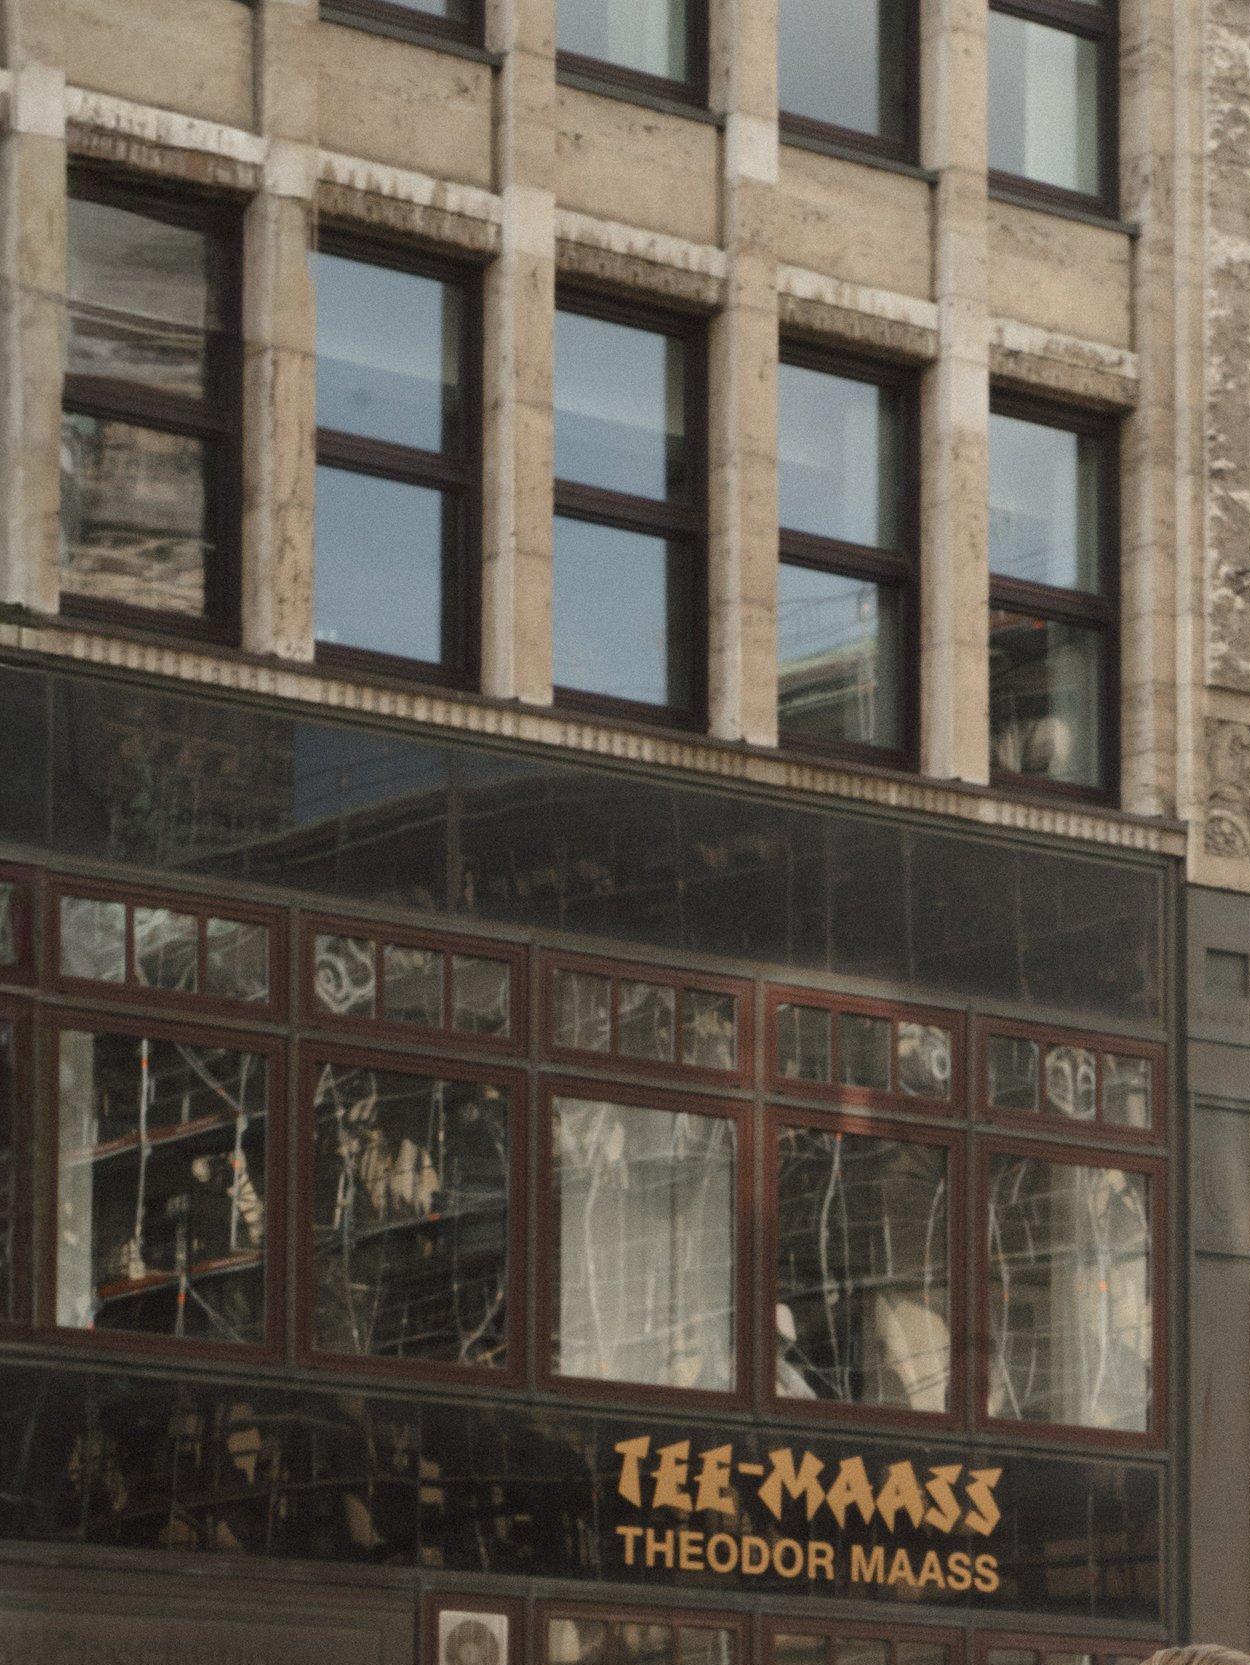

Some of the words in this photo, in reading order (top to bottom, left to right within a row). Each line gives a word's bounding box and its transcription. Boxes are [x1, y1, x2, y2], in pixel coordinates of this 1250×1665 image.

[614, 1435, 1003, 1537] TEE-MAASS
[616, 1526, 835, 1580] THEODOR
[851, 1544, 1000, 1593] MAASS
